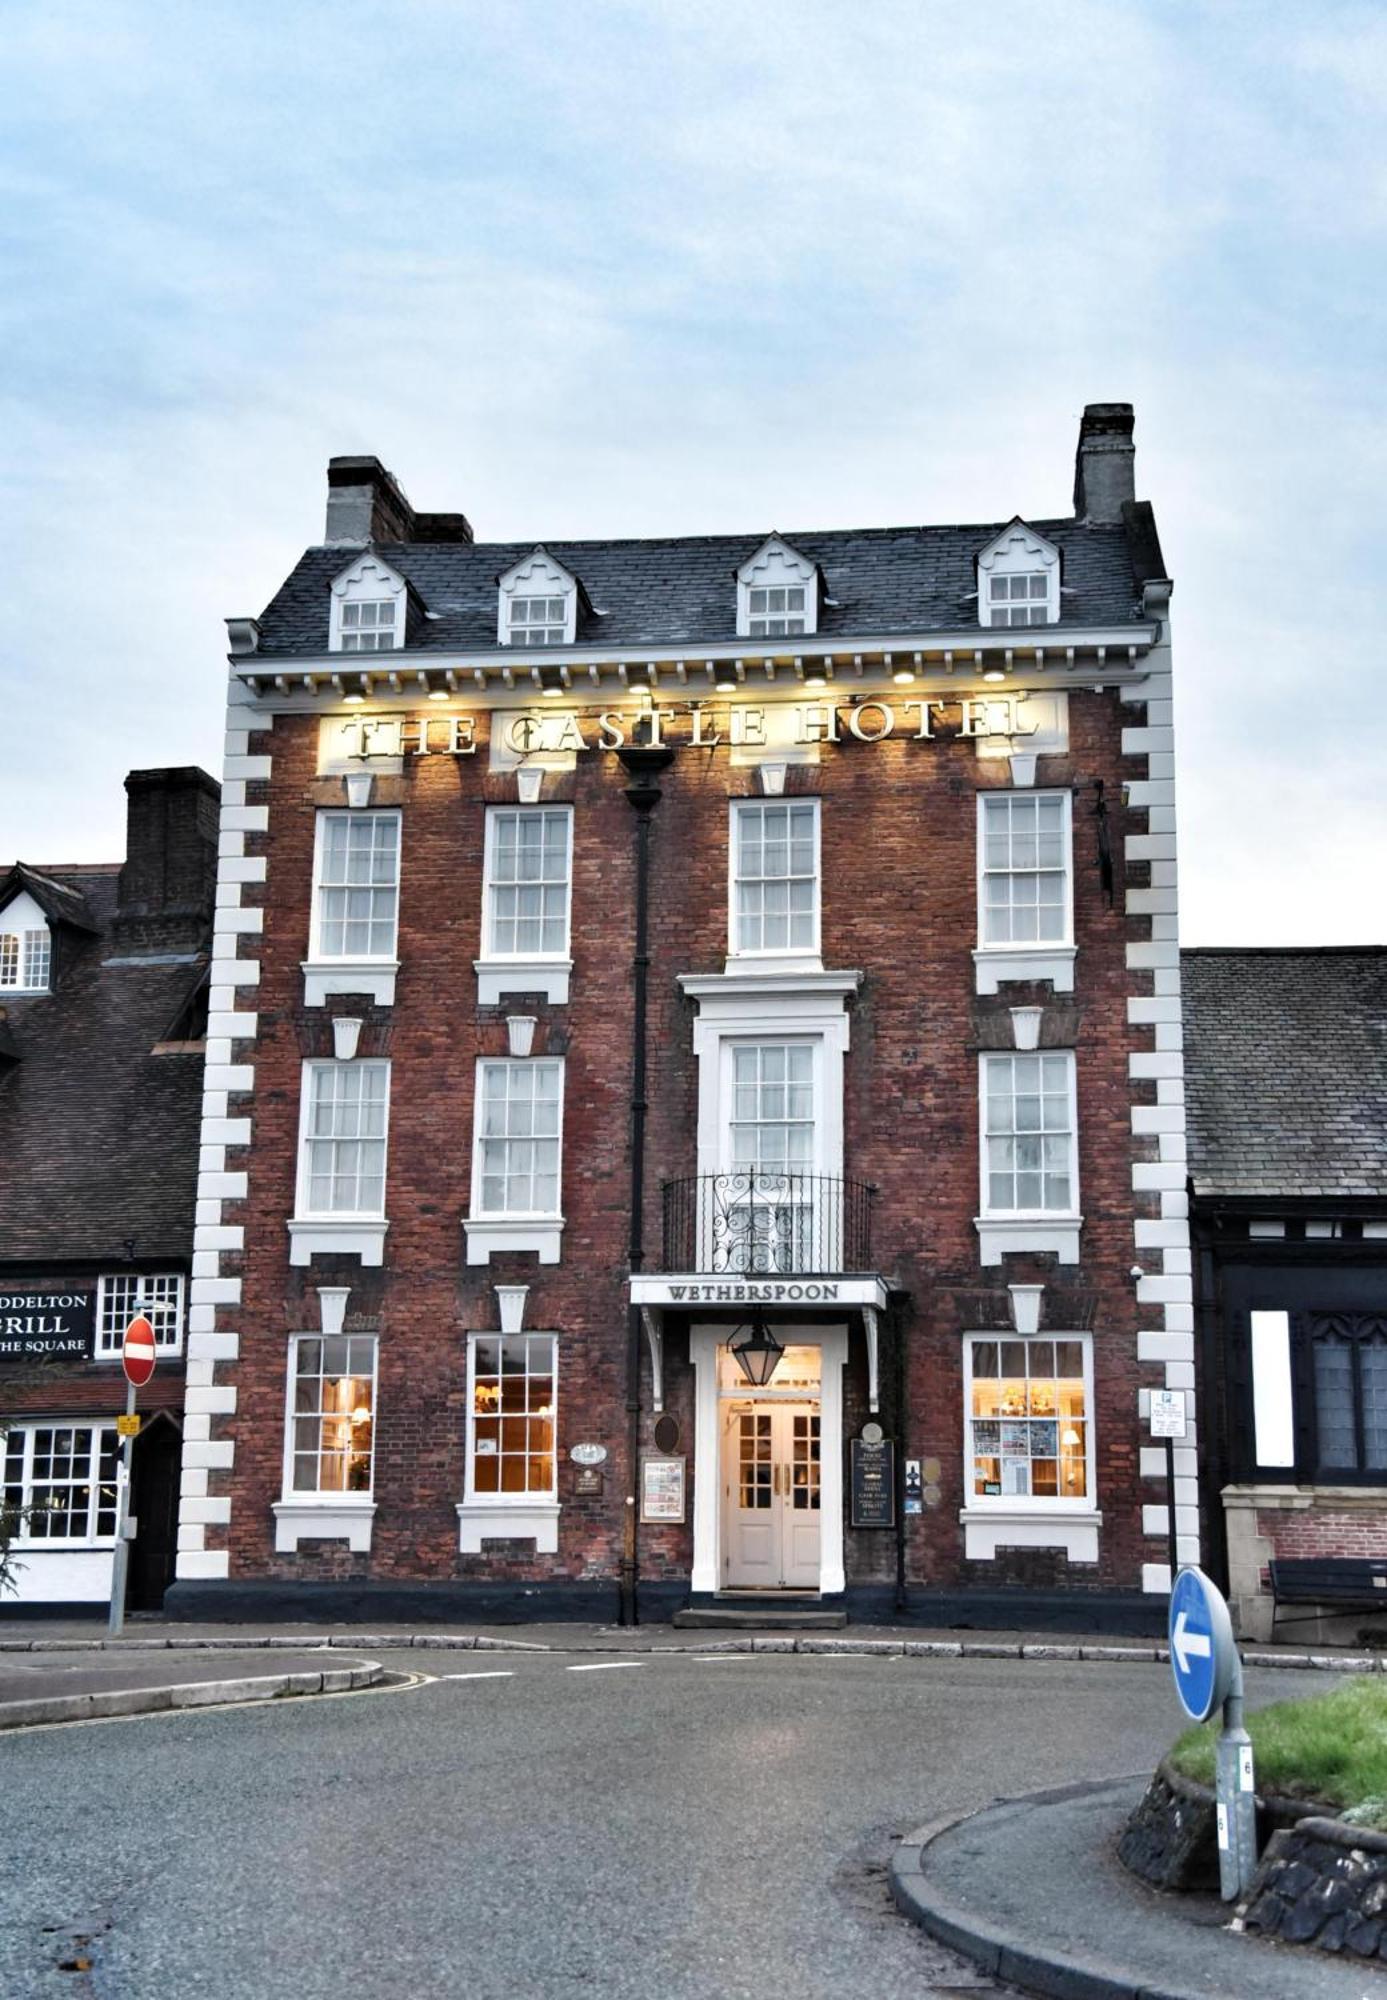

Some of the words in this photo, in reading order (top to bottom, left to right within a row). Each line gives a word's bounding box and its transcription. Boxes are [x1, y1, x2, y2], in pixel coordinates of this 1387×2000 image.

[341, 717, 476, 758] THE
[504, 704, 768, 754] CASTLE
[795, 695, 1040, 744] HOTEL
[668, 1284, 839, 1301] WETHERSPOON
[0, 1316, 70, 1334] RILL
[0, 1341, 22, 1352] HE
[25, 1339, 86, 1352] SQUARE
